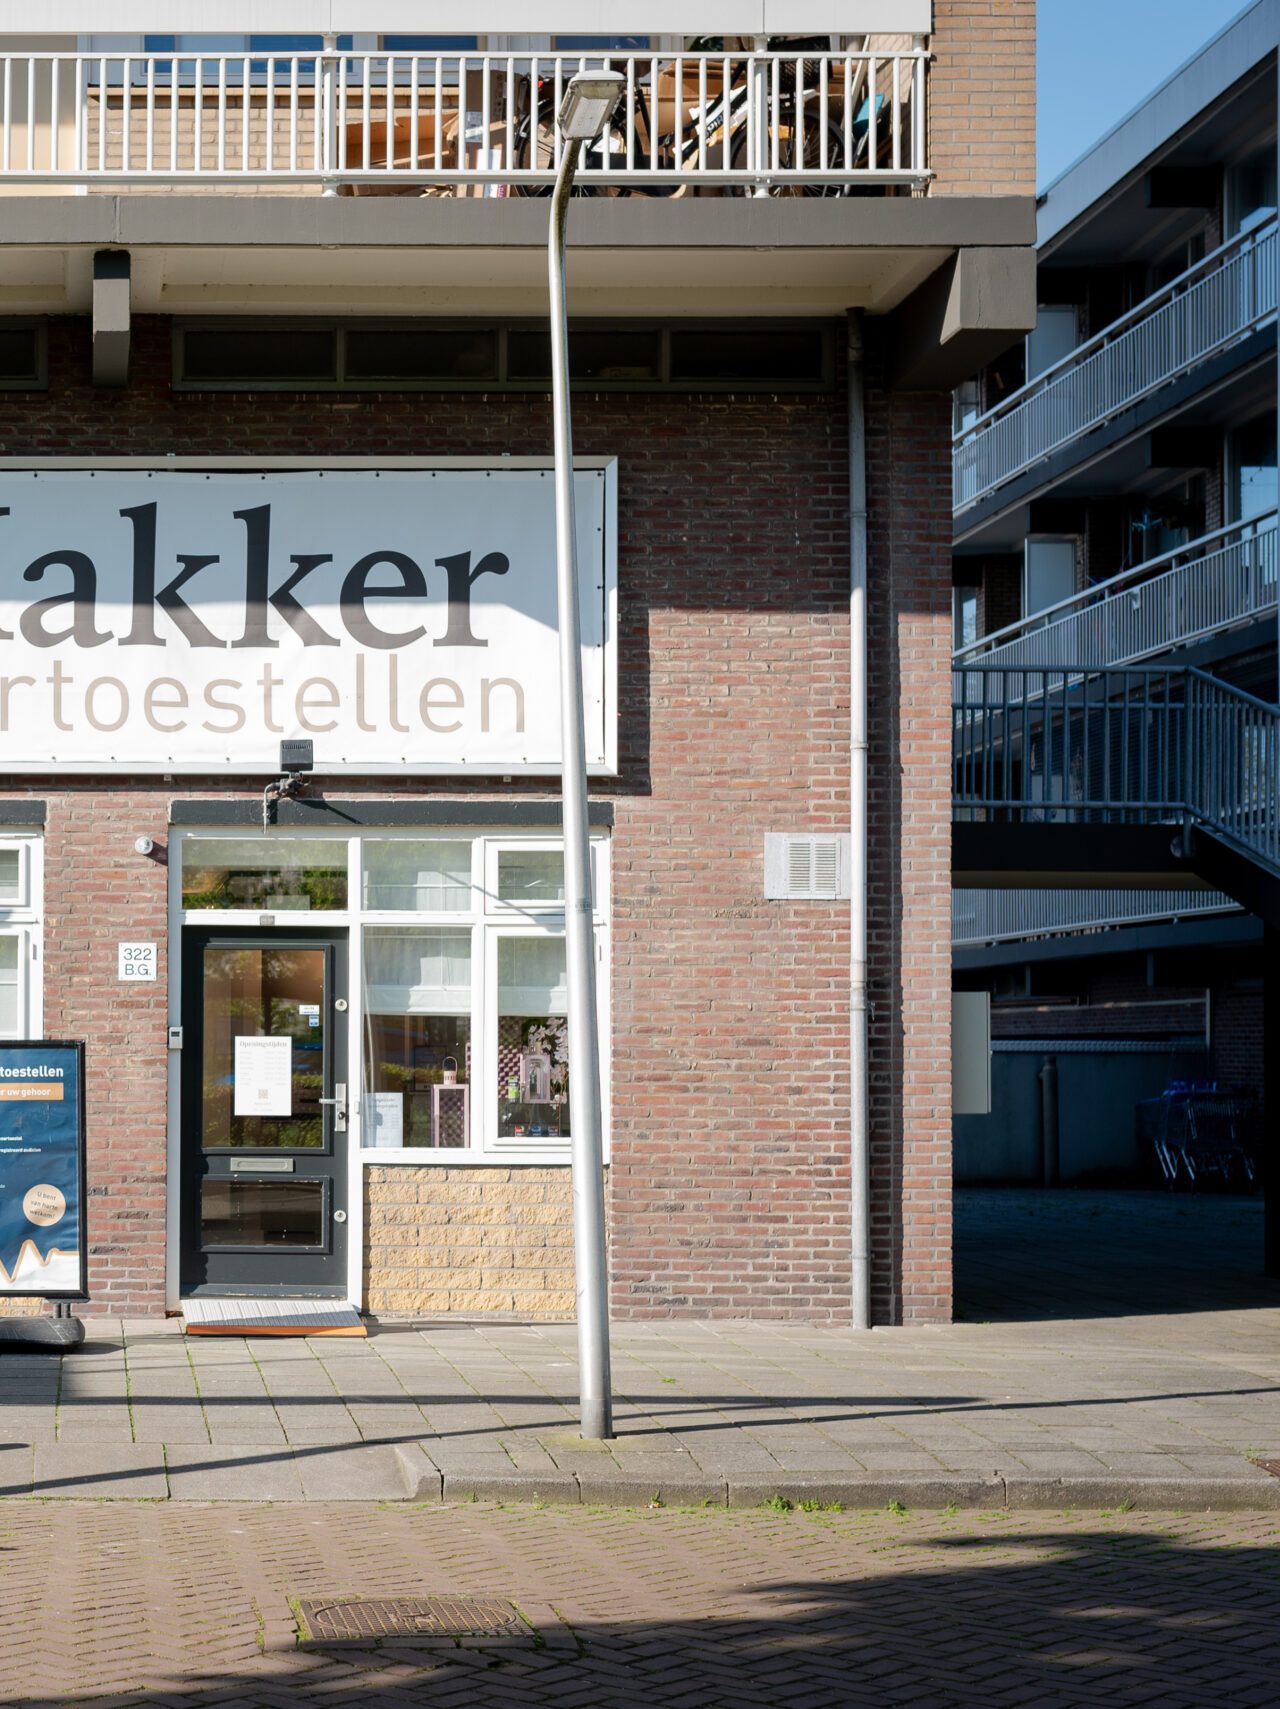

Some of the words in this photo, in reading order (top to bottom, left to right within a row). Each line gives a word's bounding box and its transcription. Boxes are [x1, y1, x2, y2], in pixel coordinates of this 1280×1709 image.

[123, 947, 152, 961] 322
[124, 963, 152, 976] B.G.
[21, 1088, 52, 1098] gehoor
